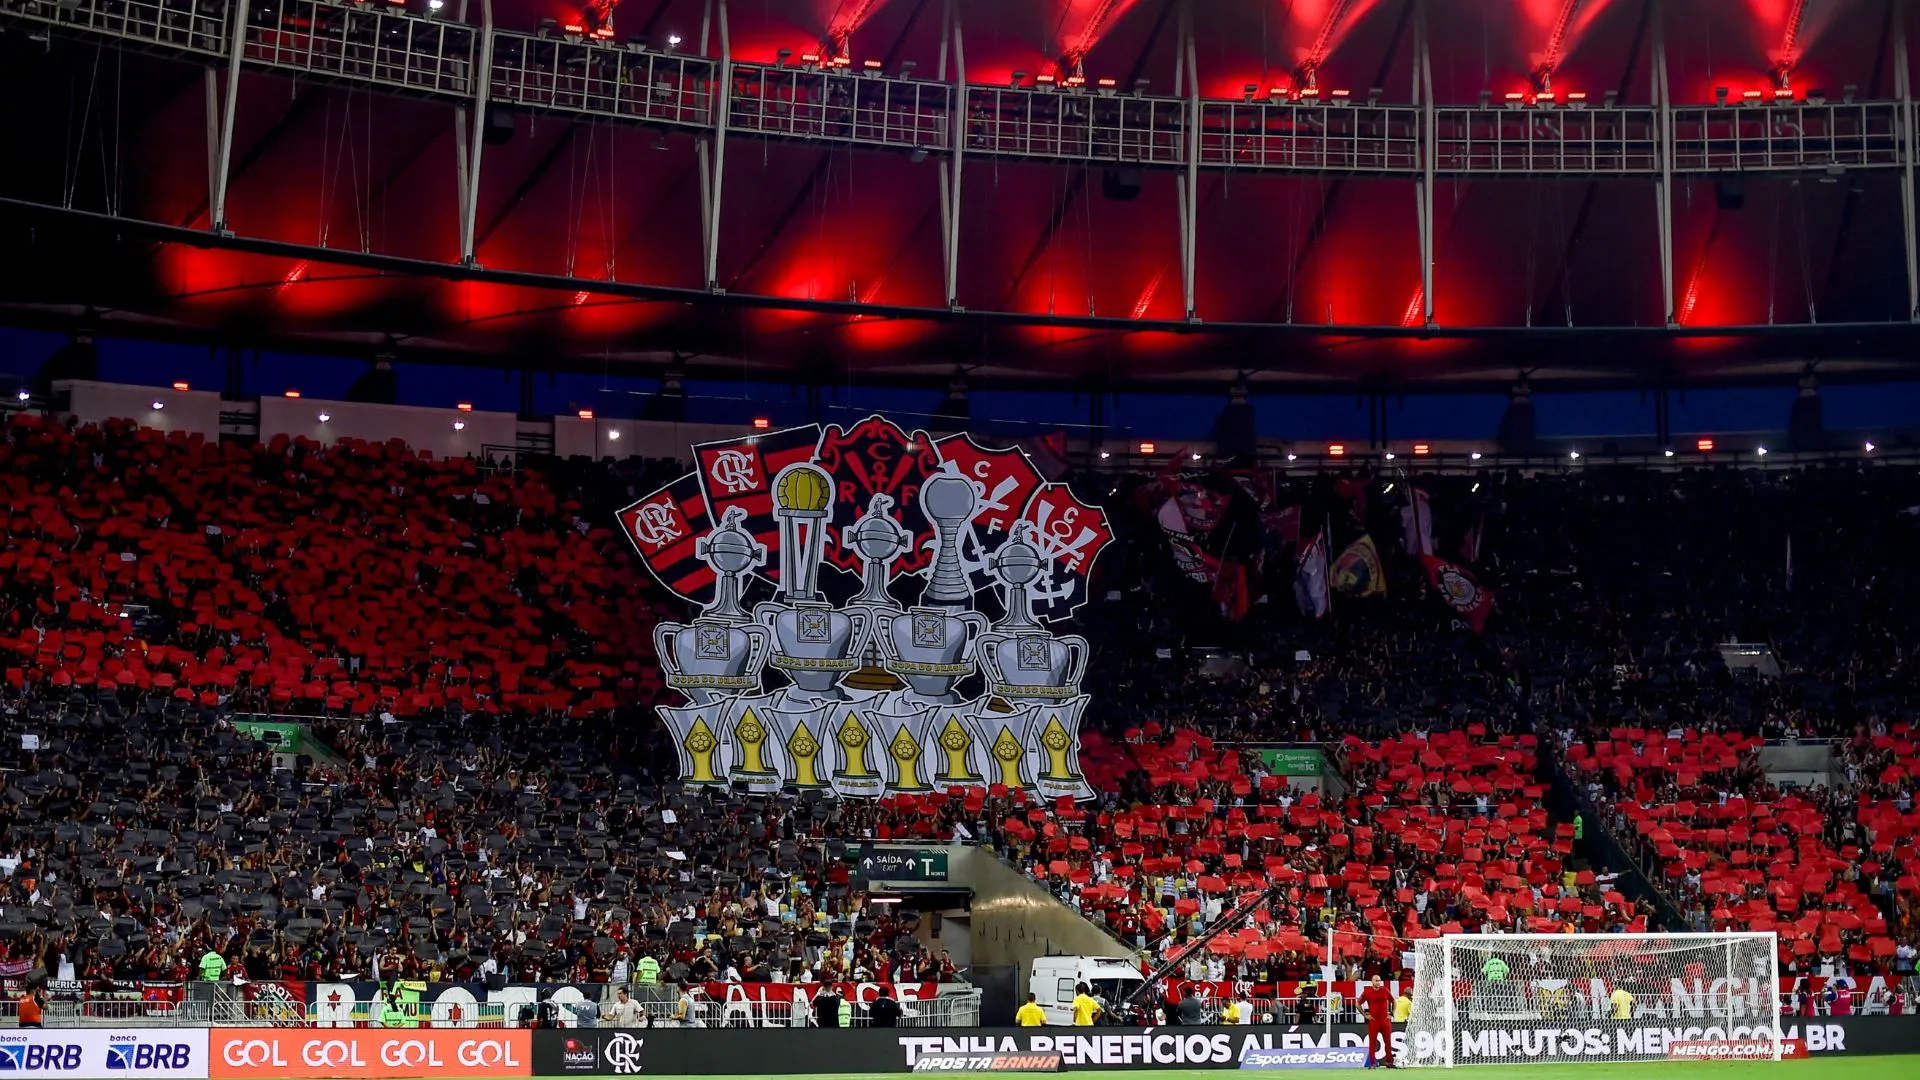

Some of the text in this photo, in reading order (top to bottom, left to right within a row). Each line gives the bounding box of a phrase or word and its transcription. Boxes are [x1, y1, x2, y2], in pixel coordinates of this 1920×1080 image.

[876, 854, 902, 864] SAÍDA
[882, 864, 898, 872] EXIT
[921, 858, 934, 876] T
[110, 1034, 137, 1042] banco
[1030, 1027, 1231, 1065] BENEFÍCIOS
[25, 1044, 83, 1070] BRB
[134, 1044, 191, 1069] BRB
[223, 1040, 519, 1067] GOL GOL GOL GOL
[565, 1051, 594, 1063] NAÇÃO
